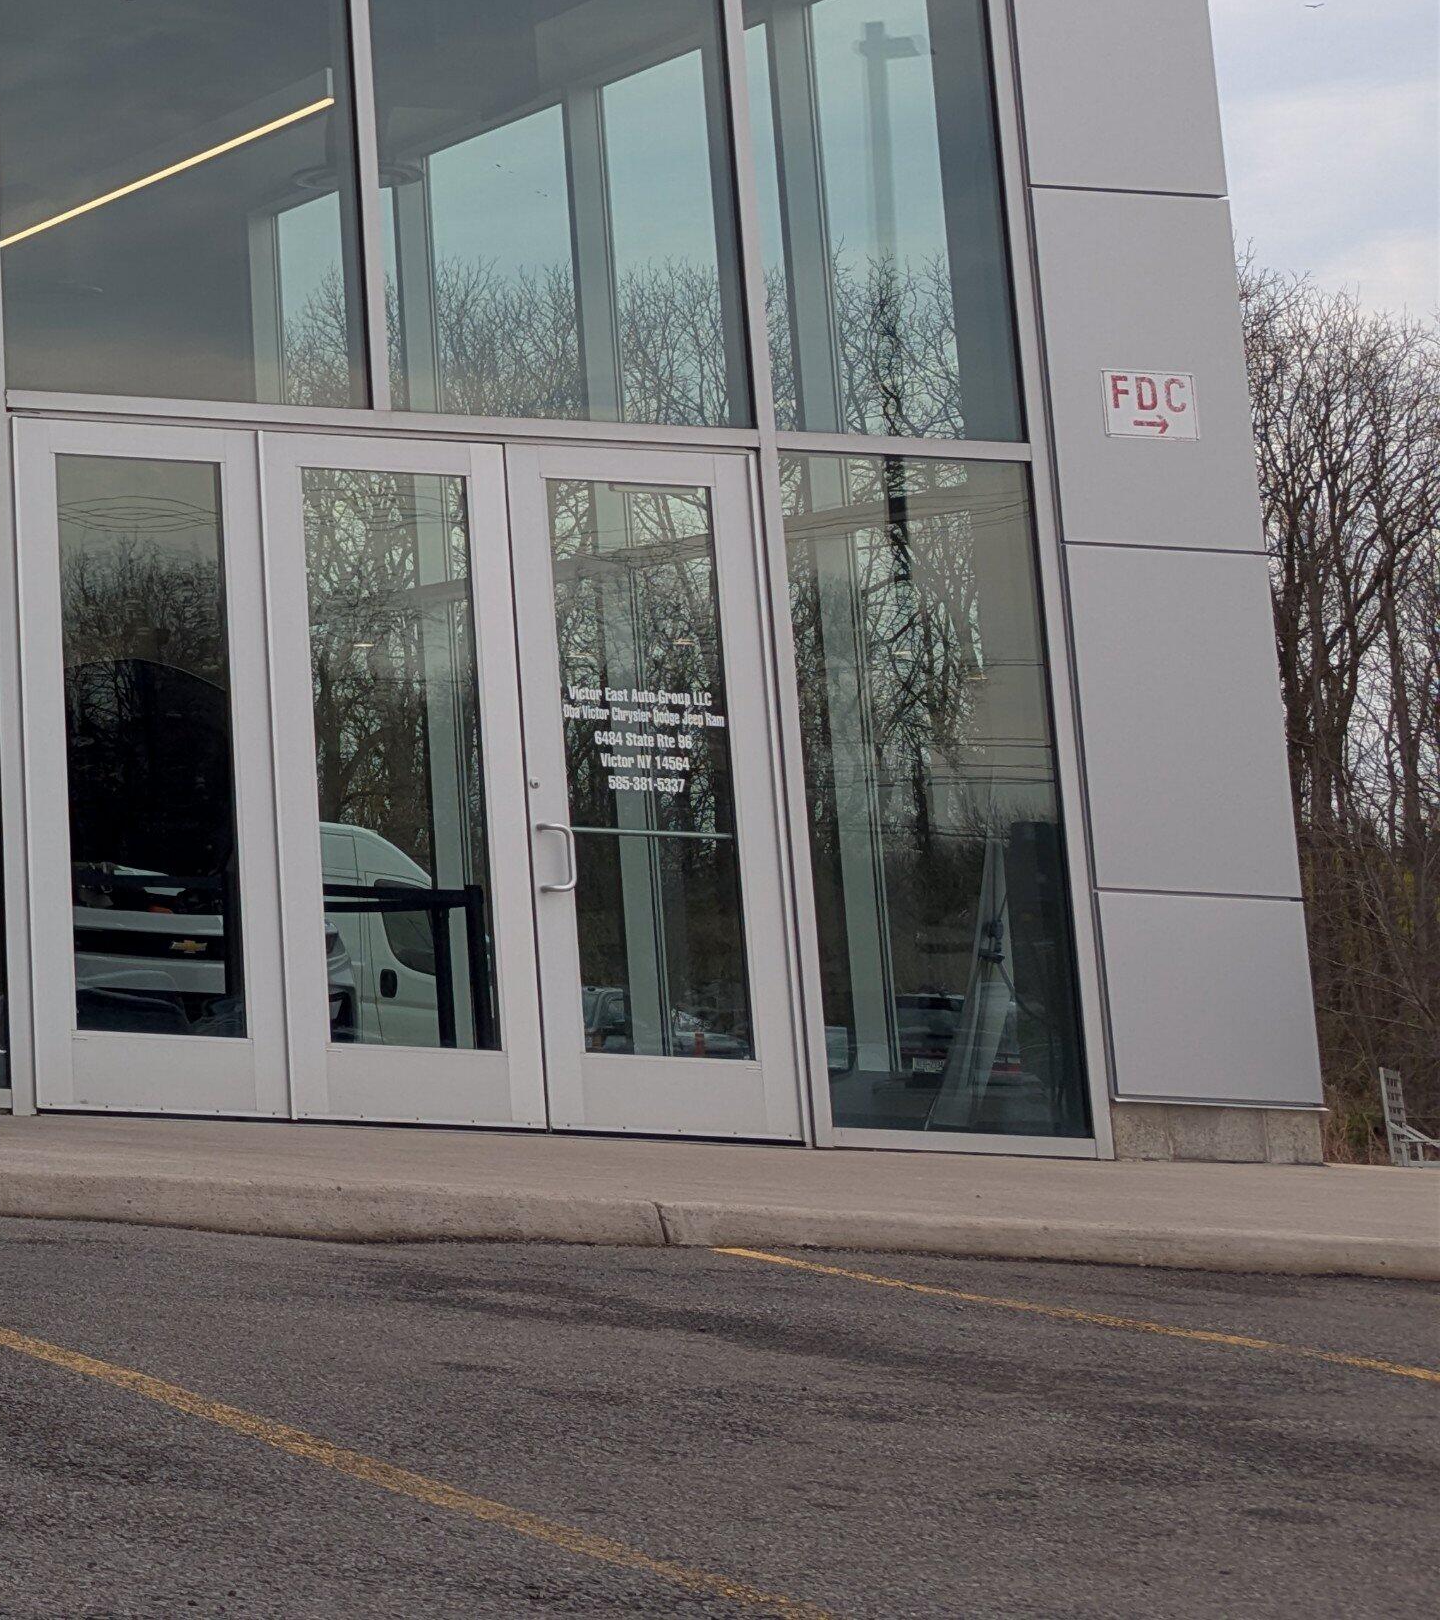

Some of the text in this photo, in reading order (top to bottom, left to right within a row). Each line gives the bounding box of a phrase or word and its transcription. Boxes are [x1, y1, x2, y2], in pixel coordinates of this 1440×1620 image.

[1110, 374, 1187, 413] FDC
[568, 684, 712, 706] Victor East Auto Group LLC
[580, 705, 609, 720] Victor
[612, 706, 650, 724] Chrysler
[653, 708, 680, 726] Dodge
[706, 711, 725, 727] Ram
[594, 731, 623, 746] 6484
[626, 732, 654, 747] State
[657, 733, 675, 748] Rte
[600, 753, 690, 771] Victor NY 14564
